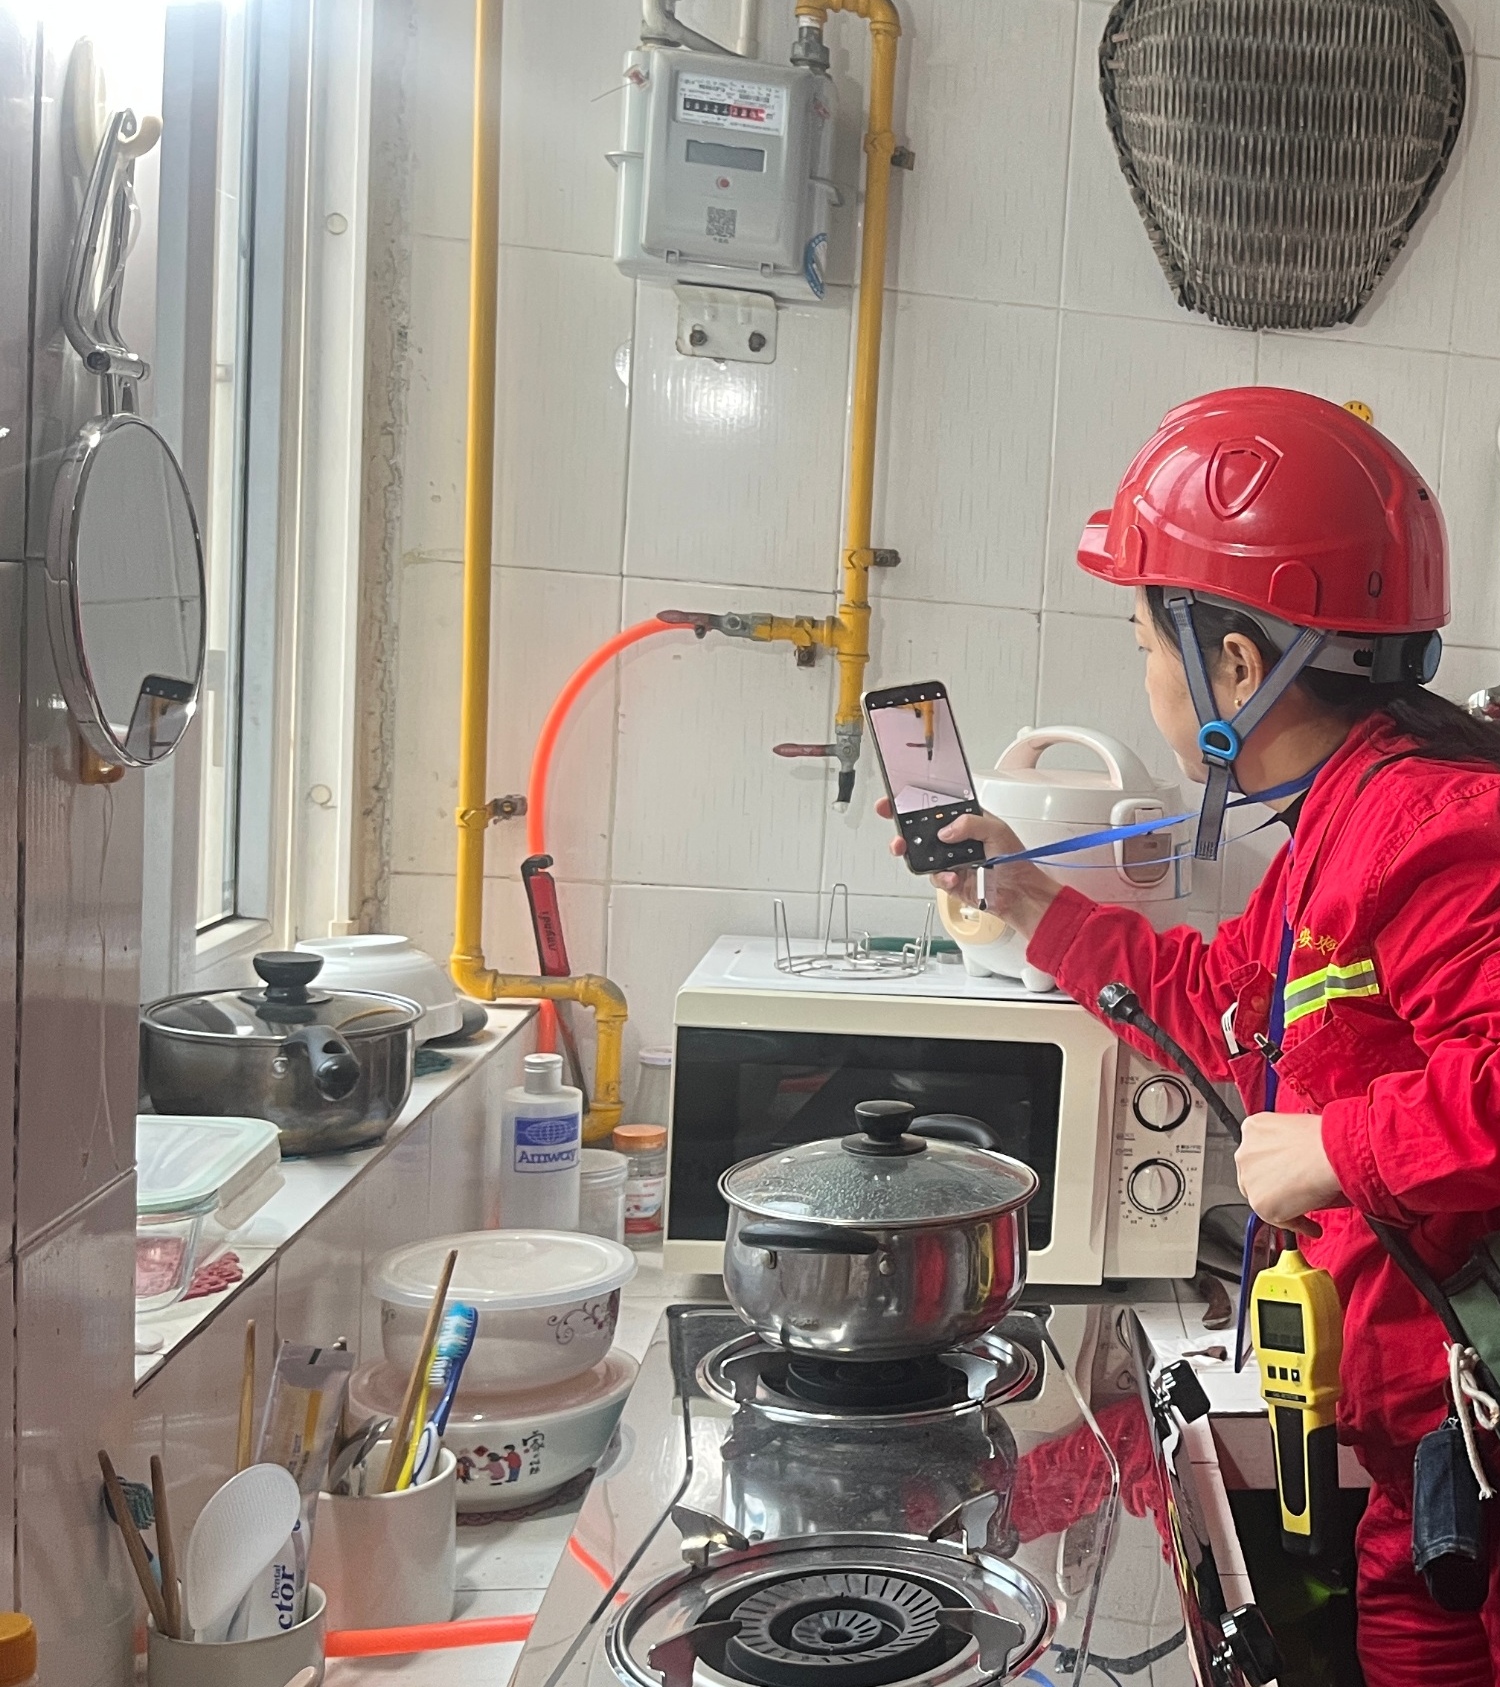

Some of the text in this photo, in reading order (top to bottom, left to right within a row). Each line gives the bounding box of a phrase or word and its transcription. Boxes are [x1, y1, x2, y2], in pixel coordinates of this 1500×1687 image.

[518, 1149, 577, 1164] Amway
[271, 1564, 282, 1600] Dental
[275, 1565, 295, 1630] ctor
